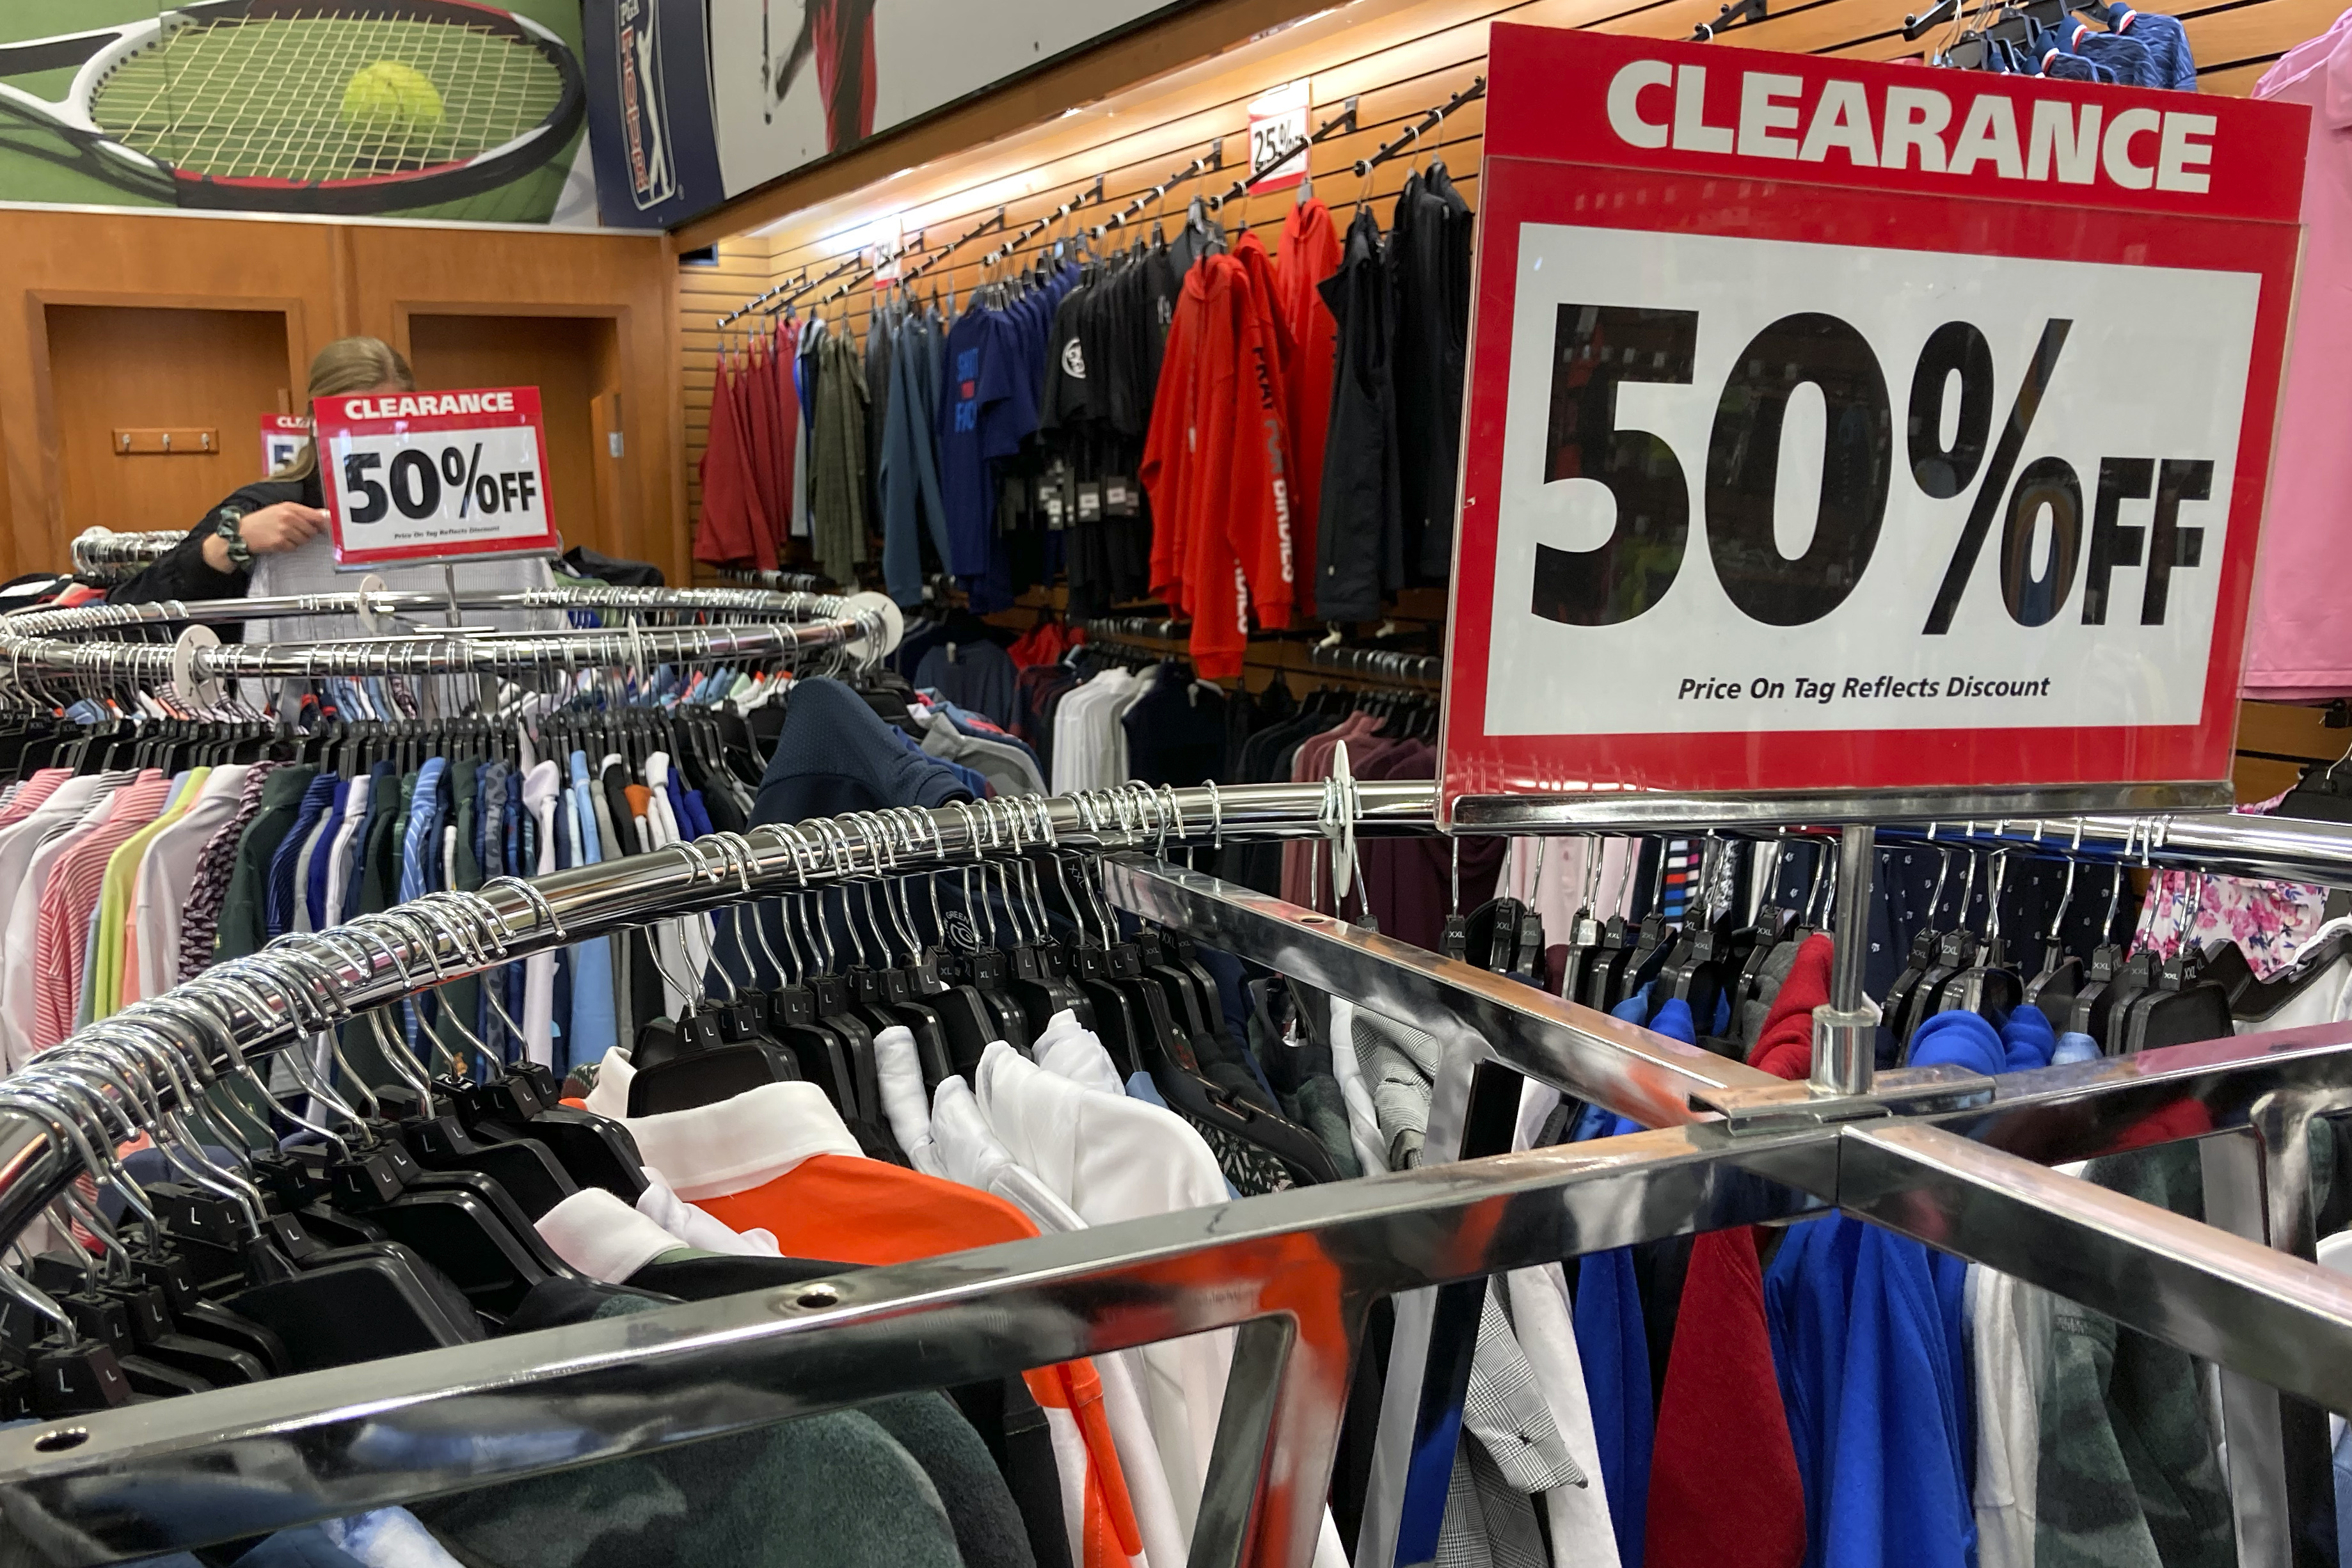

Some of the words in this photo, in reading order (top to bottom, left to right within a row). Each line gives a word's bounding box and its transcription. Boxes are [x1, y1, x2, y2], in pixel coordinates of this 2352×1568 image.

[621, 26, 649, 193] TOUR
[1608, 60, 2217, 193] CLEARANCE
[345, 392, 514, 420] CLEARANCE
[1679, 677, 1742, 700] Price
[1751, 677, 1784, 699] On
[1795, 677, 1836, 704] Tag
[1842, 676, 1940, 699] Reflects
[1946, 676, 2051, 698] Discount
[946, 910, 970, 924] GREEN
[1495, 922, 1511, 931] XXL
[1757, 927, 1772, 937] XXL
[1145, 947, 1159, 956] XXL
[1694, 942, 1710, 951] XXL
[1943, 945, 1958, 956] 2XL
[1912, 949, 1927, 959] XXL
[1054, 956, 1061, 964] L
[1088, 960, 1094, 969] L
[941, 967, 952, 976] XL
[2094, 962, 2110, 971] XXL
[980, 970, 989, 979] XL
[2164, 972, 2179, 981] XXL
[2184, 965, 2197, 980] XXL
[866, 979, 873, 989] L
[926, 975, 935, 983] L
[755, 1008, 762, 1018] L
[706, 1027, 714, 1036] L
[741, 1021, 749, 1031] L
[685, 1028, 691, 1042] L
[543, 1084, 552, 1095] L
[472, 1100, 481, 1110] L
[494, 1093, 504, 1108] L
[452, 1127, 463, 1137] L
[423, 1135, 436, 1152] L
[395, 1155, 406, 1166] L
[296, 1177, 305, 1188] L
[348, 1175, 361, 1192] L
[382, 1174, 391, 1182] L
[191, 1207, 201, 1224] L
[226, 1212, 235, 1223] L
[288, 1230, 299, 1240] L
[178, 1278, 189, 1291] L
[152, 1305, 163, 1322] L
[114, 1324, 123, 1338] L
[58, 1369, 74, 1392] L
[106, 1370, 116, 1381] L
[20, 1398, 30, 1413] L
